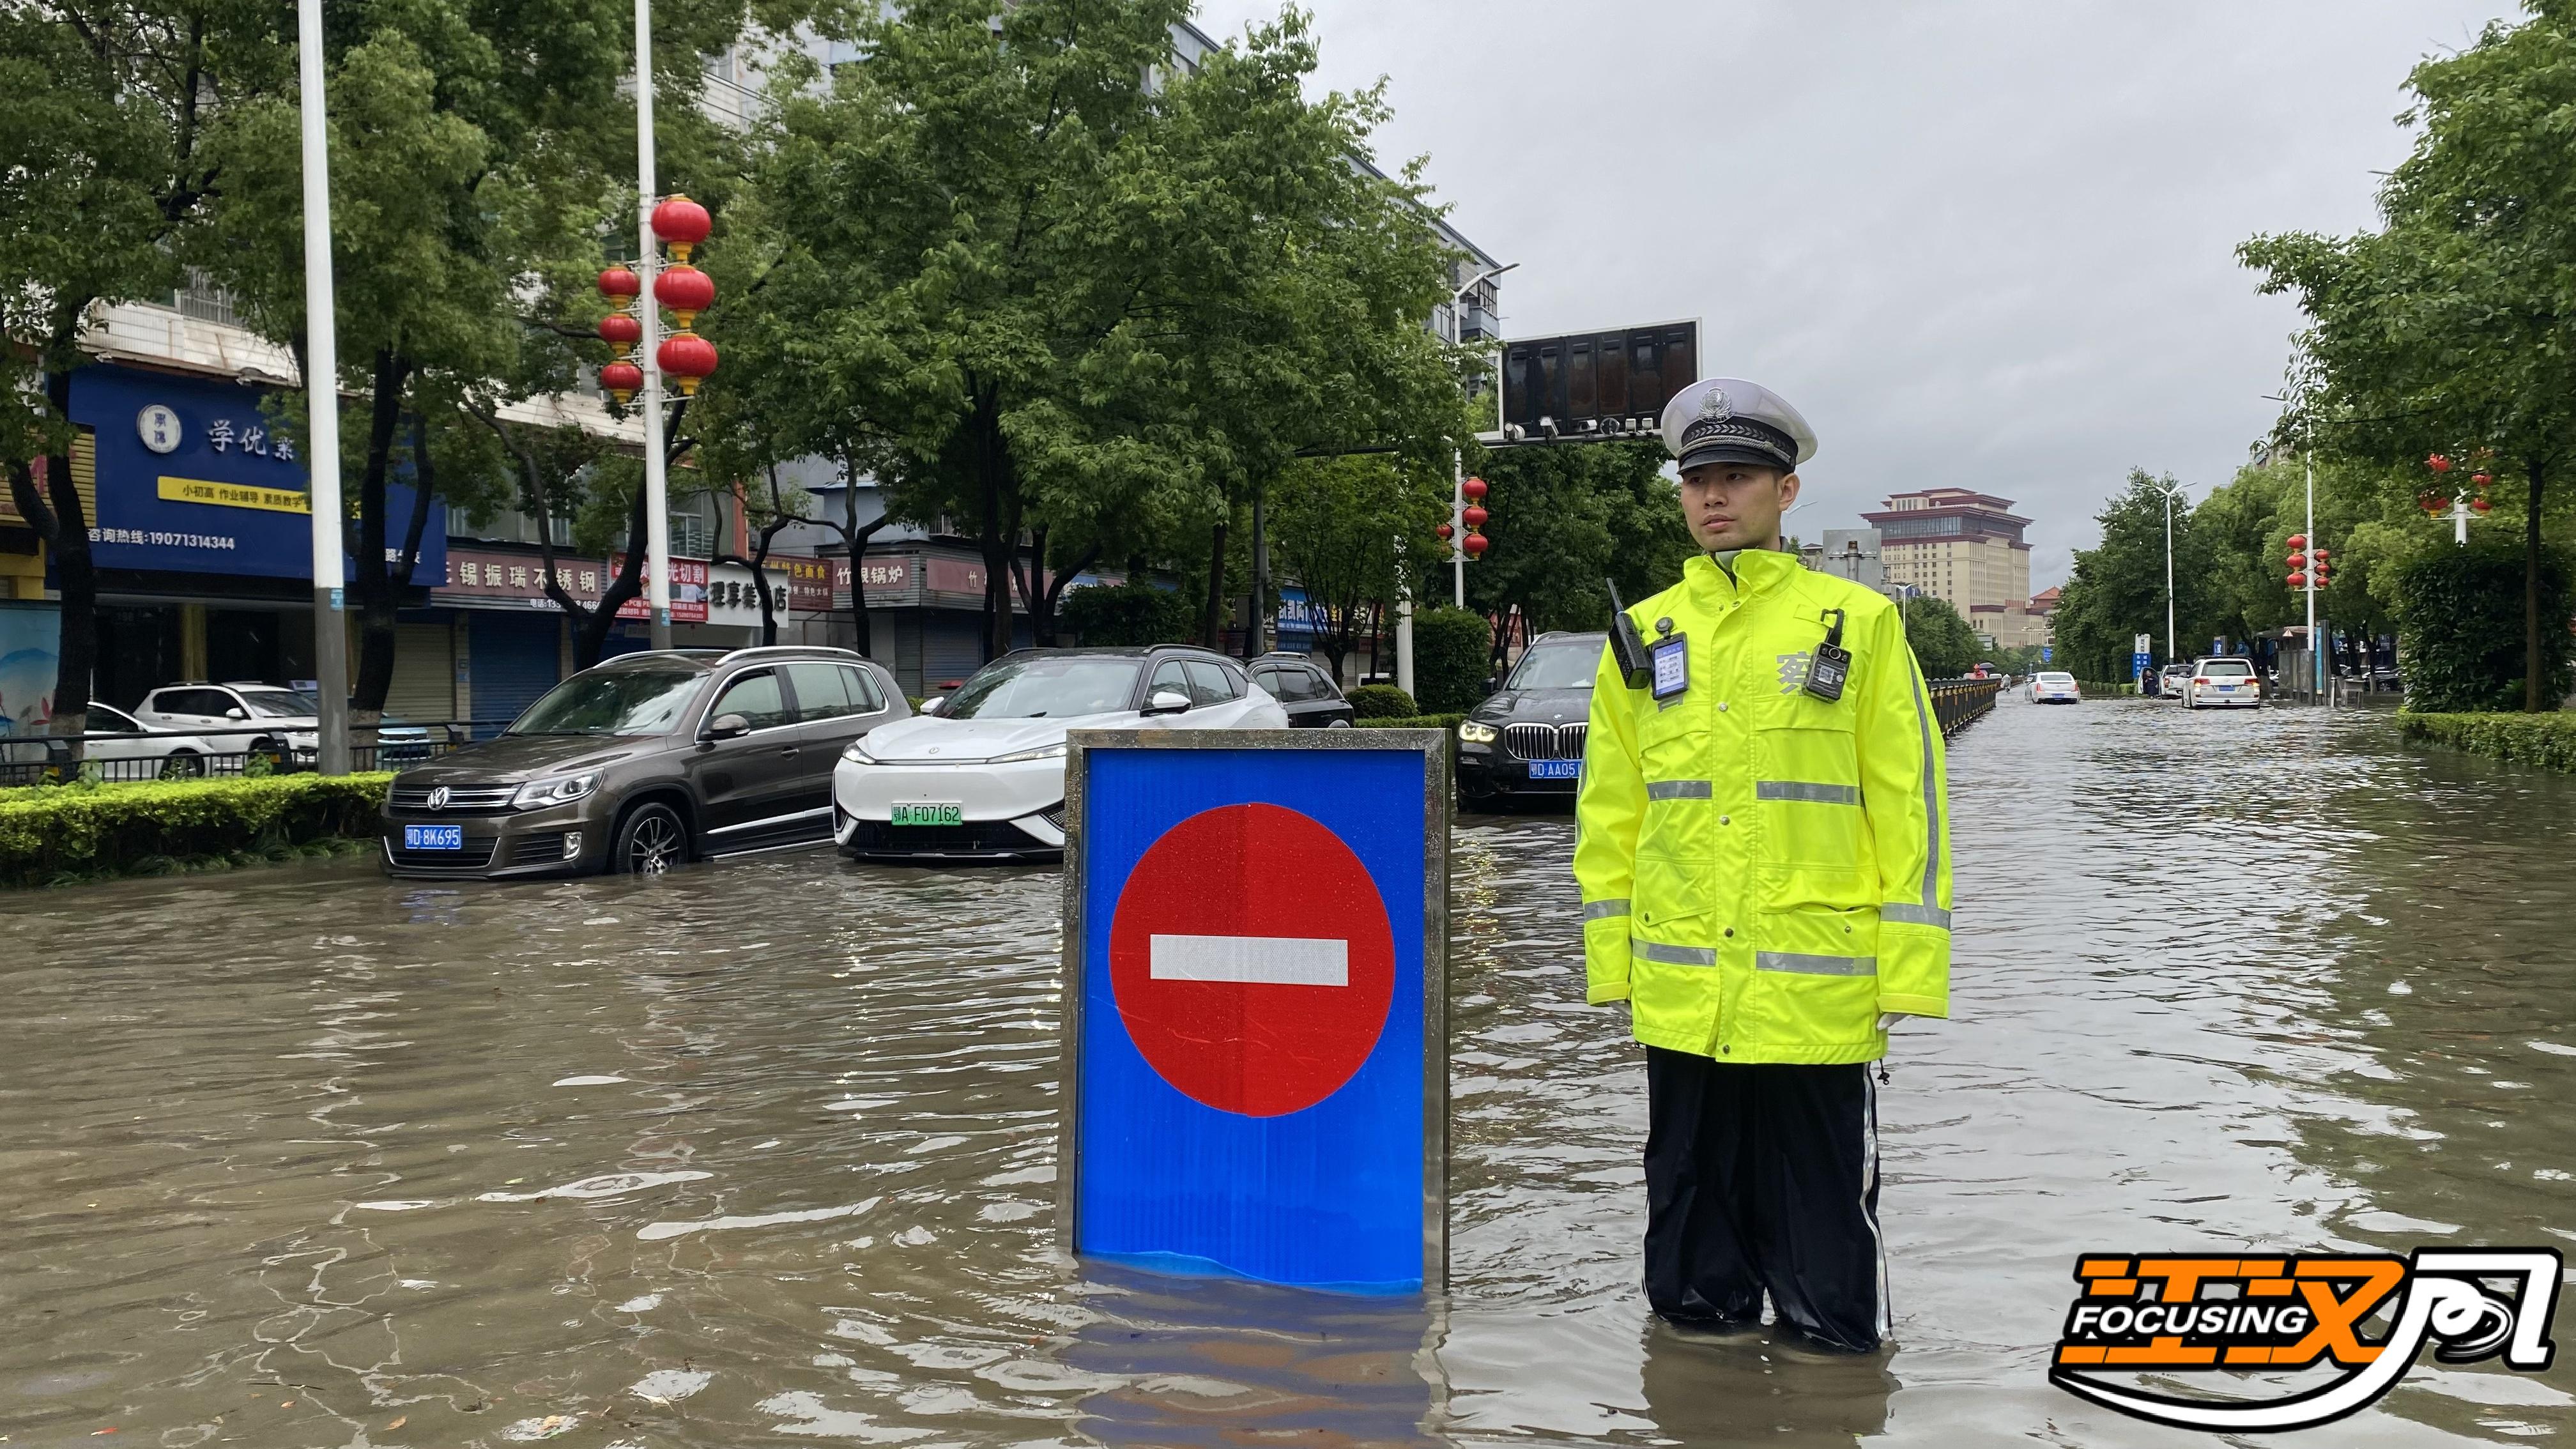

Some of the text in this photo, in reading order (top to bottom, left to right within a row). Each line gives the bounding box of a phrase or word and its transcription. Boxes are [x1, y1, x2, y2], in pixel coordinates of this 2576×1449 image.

[183, 484, 214, 498] 小初高
[219, 489, 259, 503] 作业辅导
[446, 561, 595, 592] 锡振瑞不锈钢
